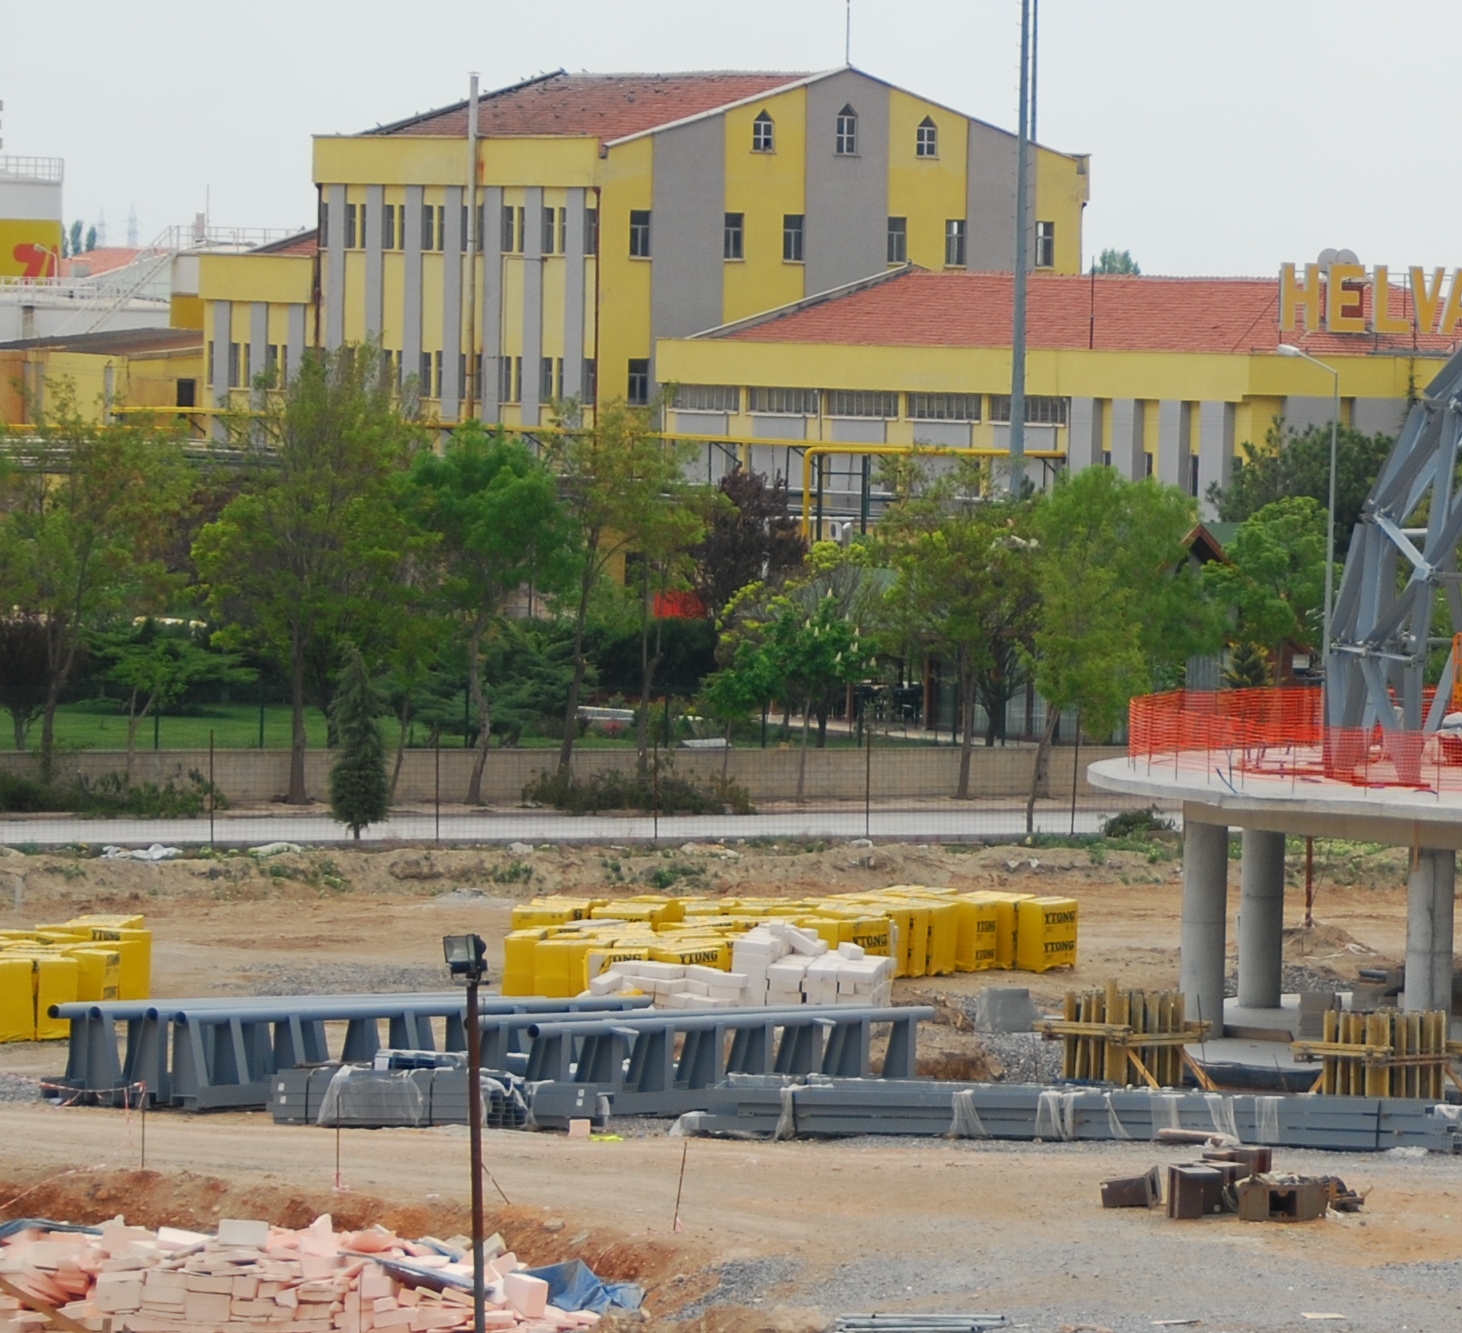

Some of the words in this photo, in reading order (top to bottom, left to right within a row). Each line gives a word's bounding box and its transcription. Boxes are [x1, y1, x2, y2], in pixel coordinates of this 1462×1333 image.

[1044, 911, 1076, 924] YTONG
[1043, 941, 1075, 953] YTONG
[679, 950, 718, 965] YTONG
